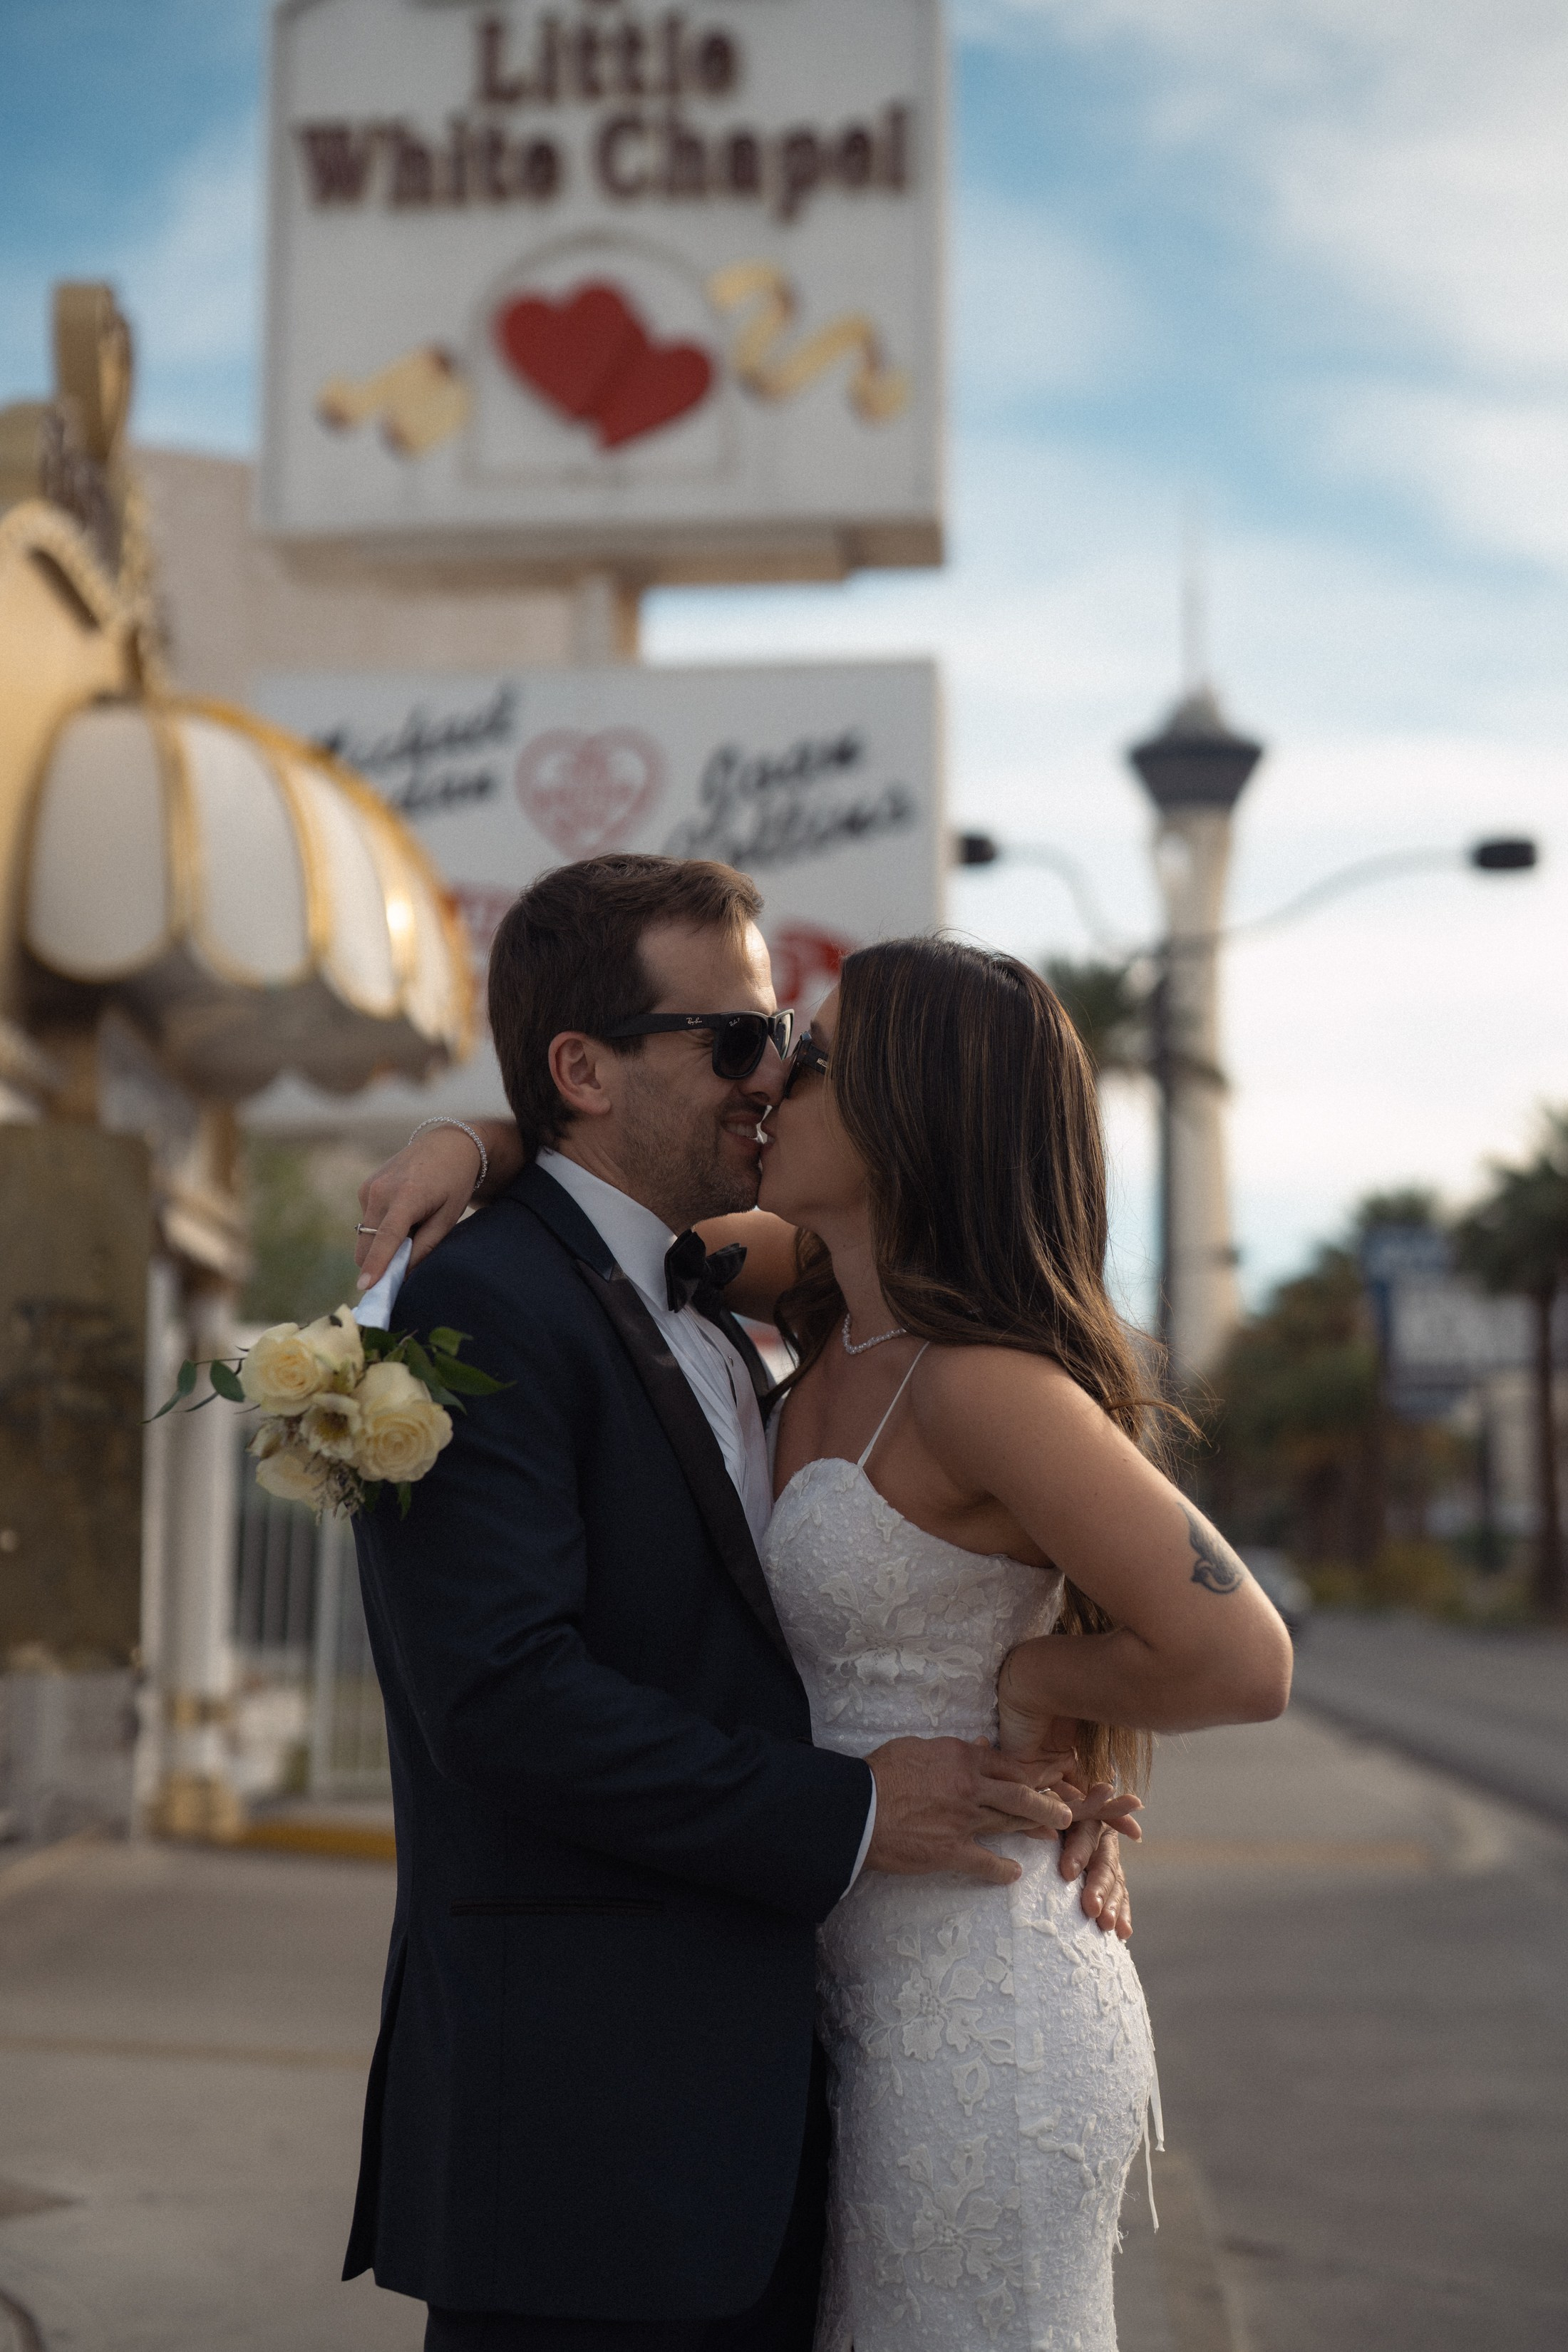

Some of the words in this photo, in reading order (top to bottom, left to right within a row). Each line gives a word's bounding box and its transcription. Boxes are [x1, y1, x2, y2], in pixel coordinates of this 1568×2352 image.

[475, 10, 740, 107] Little
[296, 116, 564, 211] White
[592, 101, 914, 225] Chapel
[686, 1016, 703, 1026] Ray-Ban
